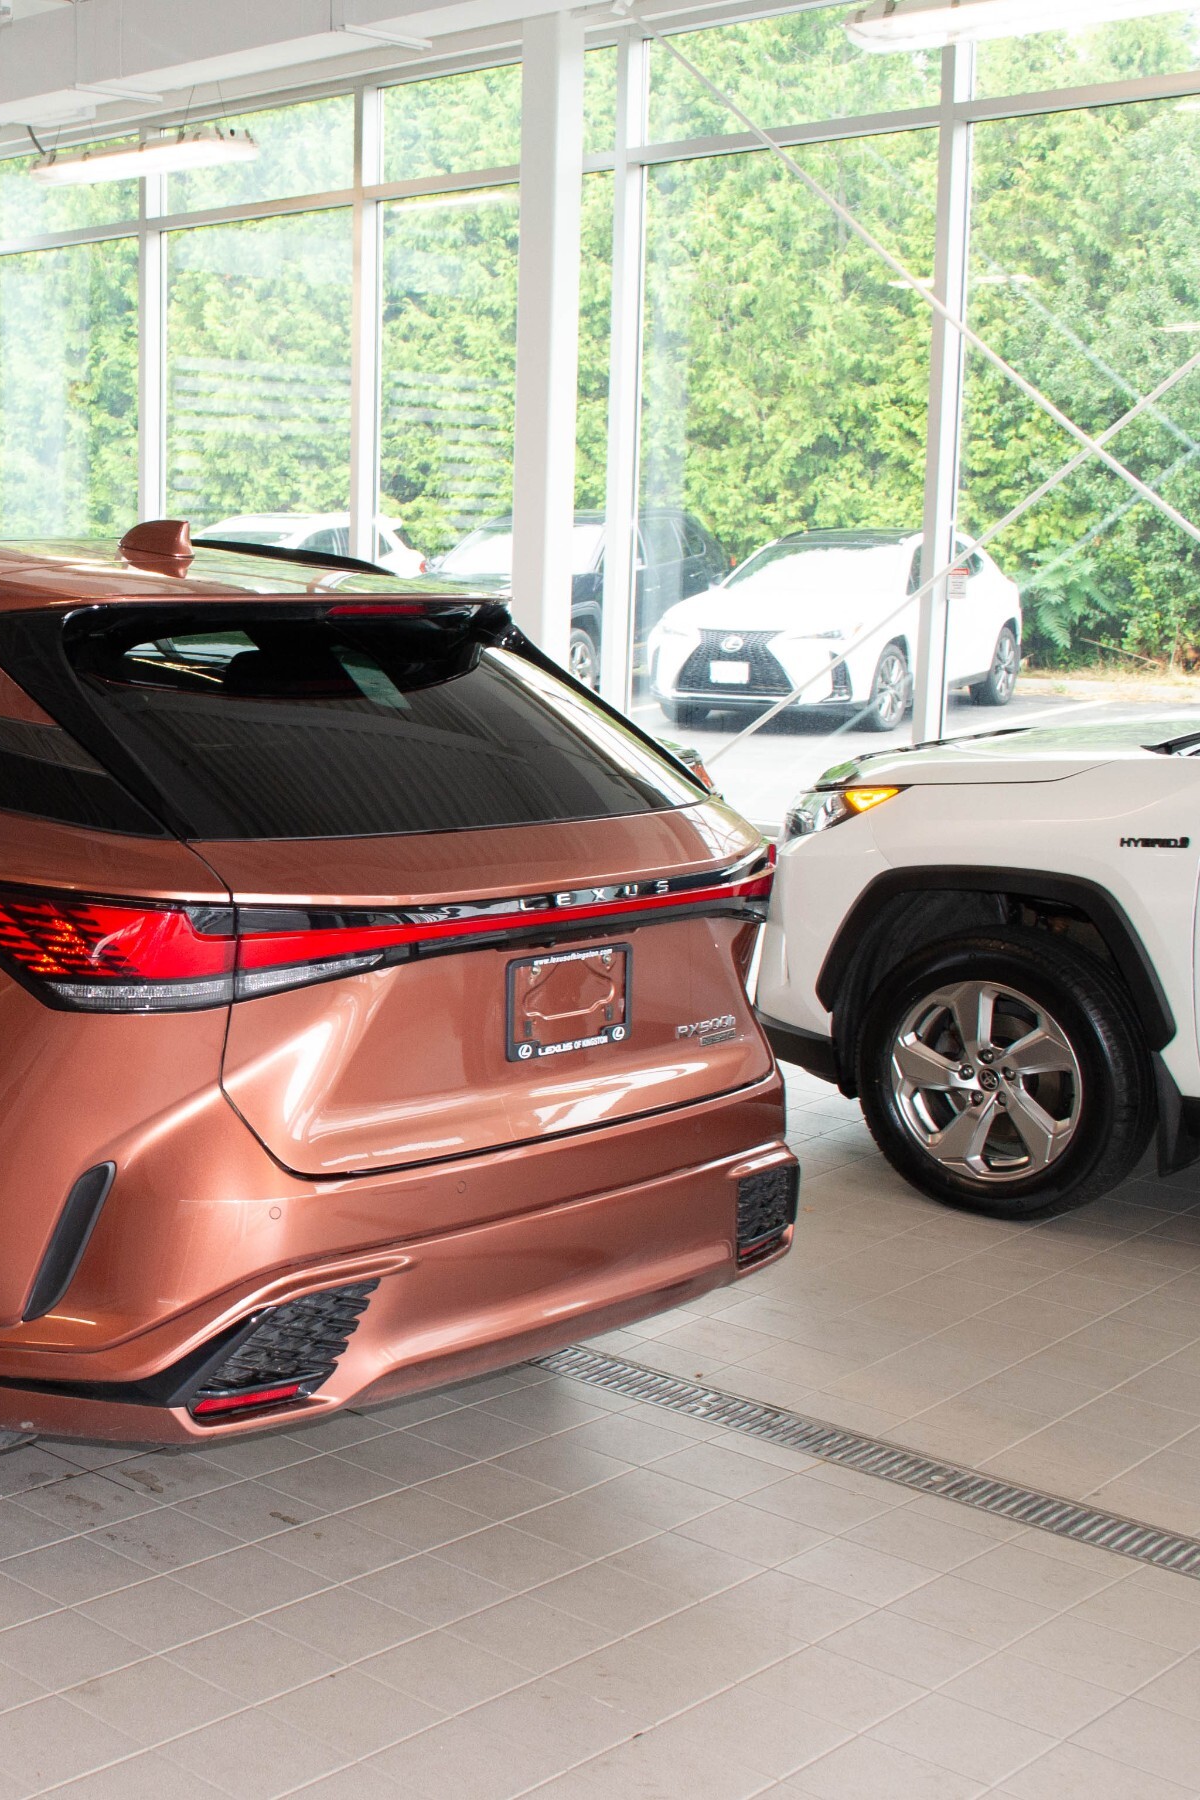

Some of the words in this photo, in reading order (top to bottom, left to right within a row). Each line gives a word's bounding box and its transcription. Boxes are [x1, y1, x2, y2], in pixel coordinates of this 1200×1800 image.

[1120, 837, 1178, 848] HYBRID
[519, 880, 669, 911] LEXUS
[538, 1042, 573, 1056] LEXUS
[574, 1040, 582, 1049] OF
[582, 1035, 608, 1047] KINGSTON
